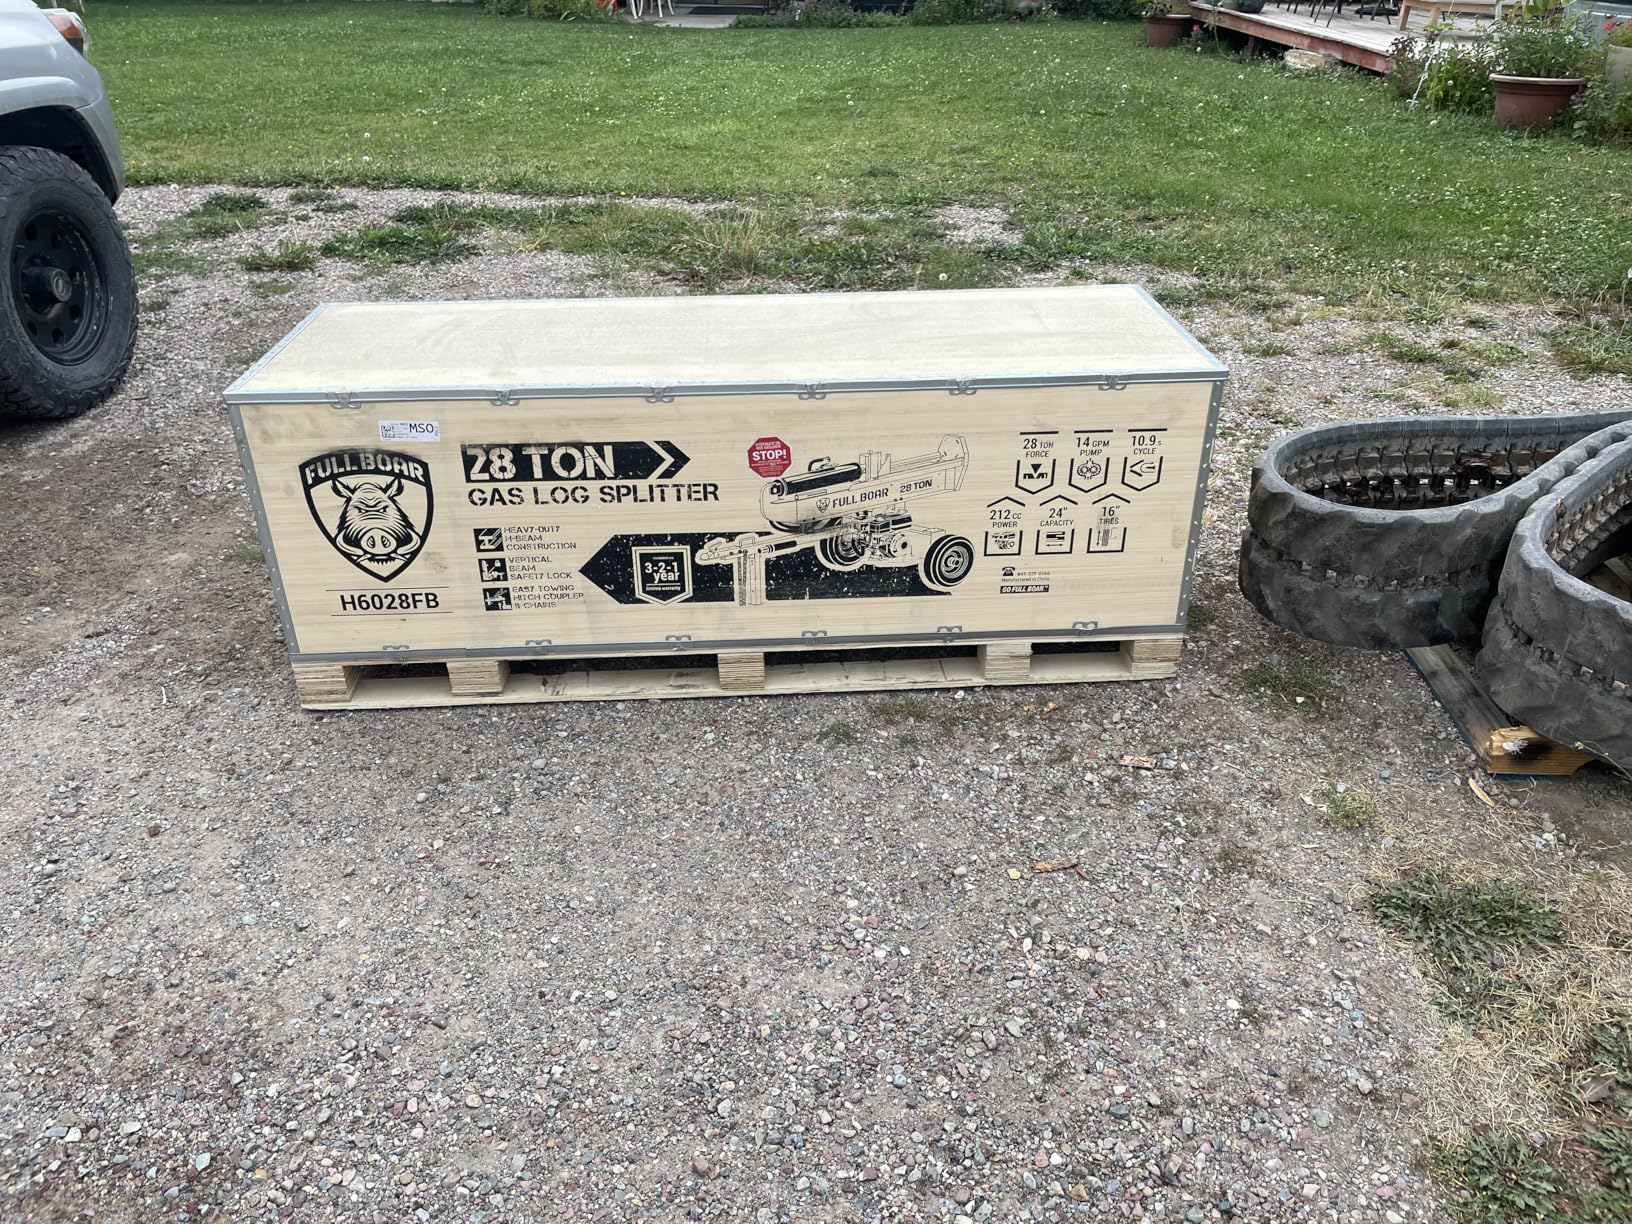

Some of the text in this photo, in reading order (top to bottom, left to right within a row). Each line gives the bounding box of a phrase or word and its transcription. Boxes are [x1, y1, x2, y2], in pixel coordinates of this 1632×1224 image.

[409, 423, 434, 433] MSO
[1023, 438, 1038, 450] 28
[1076, 437, 1110, 448] 14 GPM
[1131, 435, 1157, 447] 10.9
[752, 449, 787, 461] STOP!
[1025, 450, 1049, 458] FORCE
[466, 445, 615, 481] 28 TON
[304, 453, 425, 486] FULL BOAR
[467, 483, 720, 506] GAS LOG SPLITTER
[832, 479, 932, 508] FULL BOAR 28 TON
[990, 509, 1011, 520] 212
[1040, 519, 1074, 527] CAPACITY
[1099, 517, 1119, 525] TIRES
[503, 525, 560, 533] HEAVY-DUTY
[506, 542, 576, 550] CONSTRUCTION
[644, 562, 678, 573] 3-2-1
[653, 571, 680, 584] year
[538, 584, 575, 592] TOWING
[340, 592, 440, 611] H6028FB
[513, 592, 584, 601] HITCH COUPLER
[523, 601, 557, 609] CHAINS
